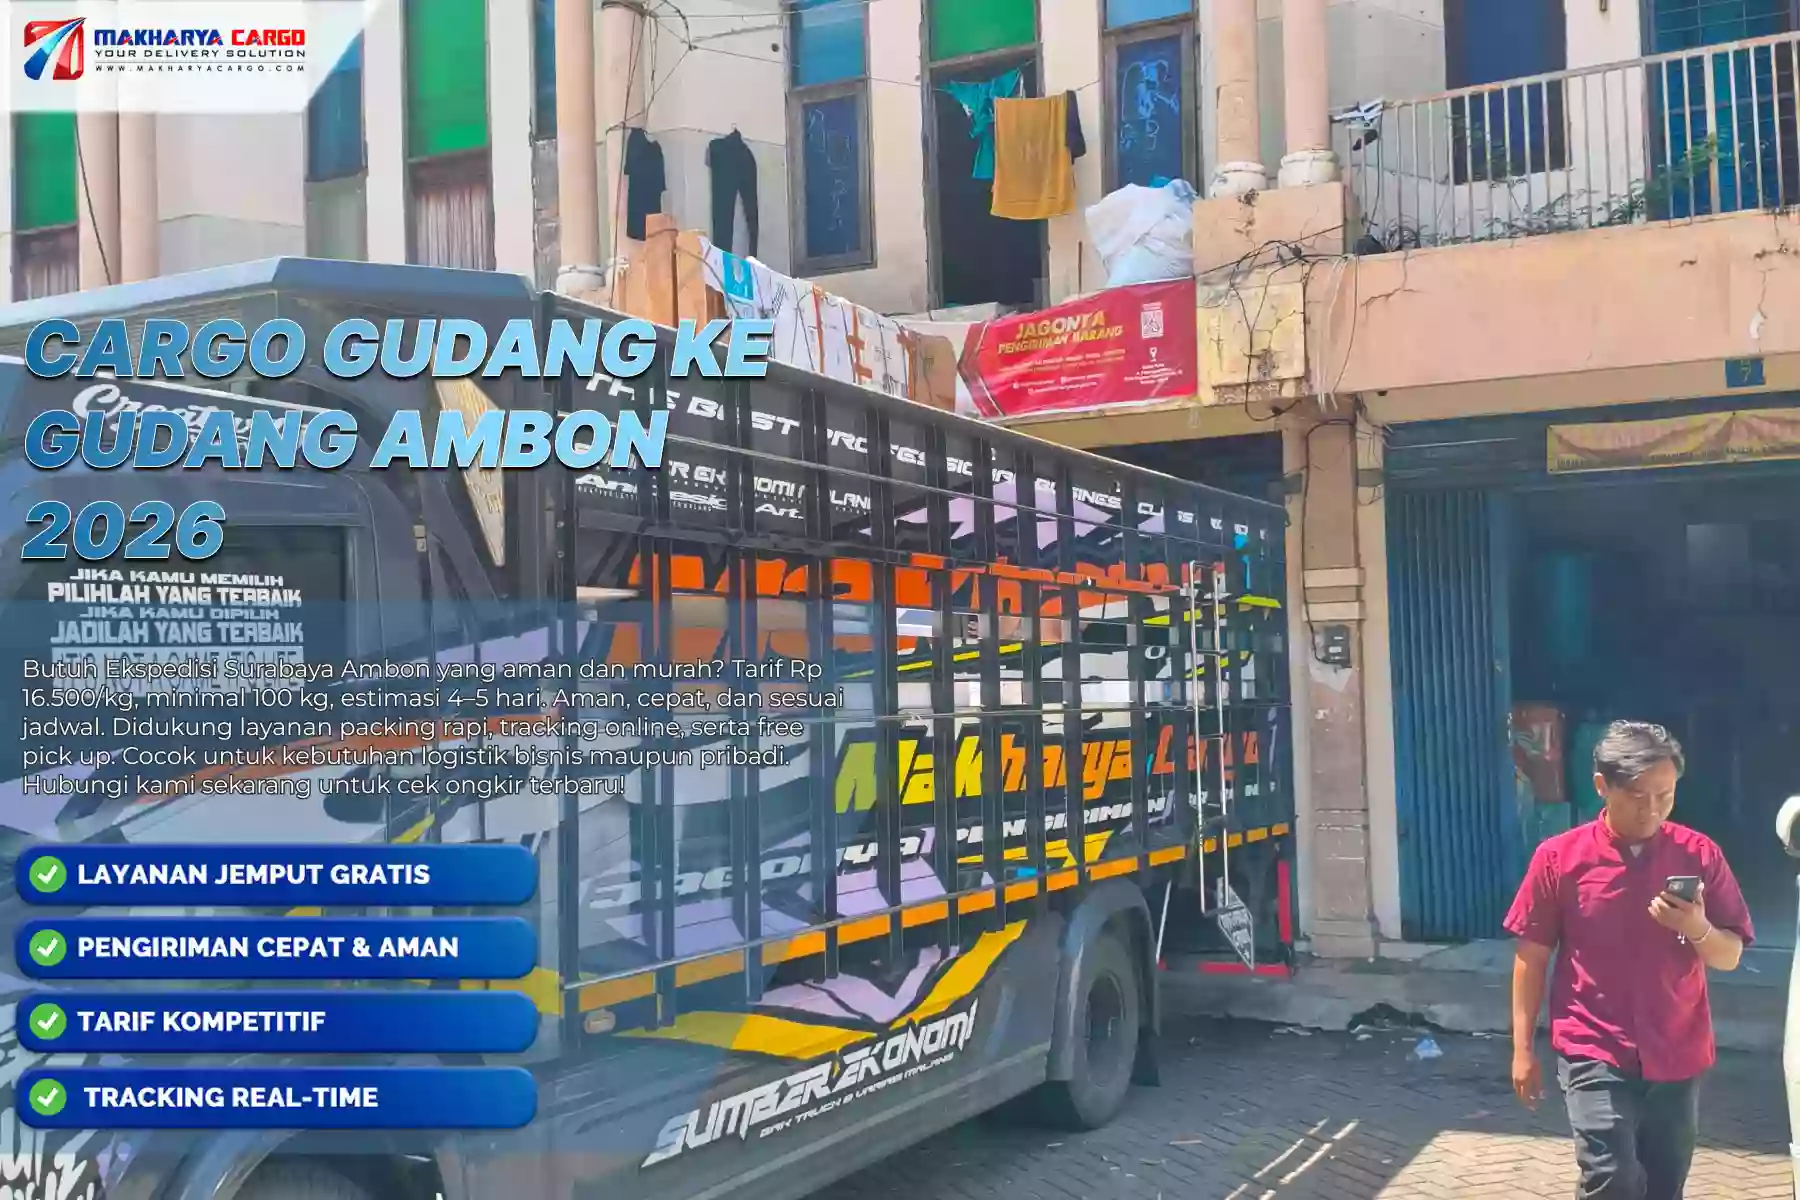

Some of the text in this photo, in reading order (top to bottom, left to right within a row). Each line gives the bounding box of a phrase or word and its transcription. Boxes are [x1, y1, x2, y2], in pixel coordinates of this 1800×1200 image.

[686, 395, 801, 436] BST
[70, 568, 284, 586] JIKA KAMU MEMILIH
[48, 582, 302, 607] PILIHLAH YANG TERBAIK
[80, 606, 280, 620] JIKA KAMU DIPILIH
[51, 621, 304, 644] JADILAH YANG TERBAIK
[640, 998, 979, 1168] SUMBER EKONOMI
